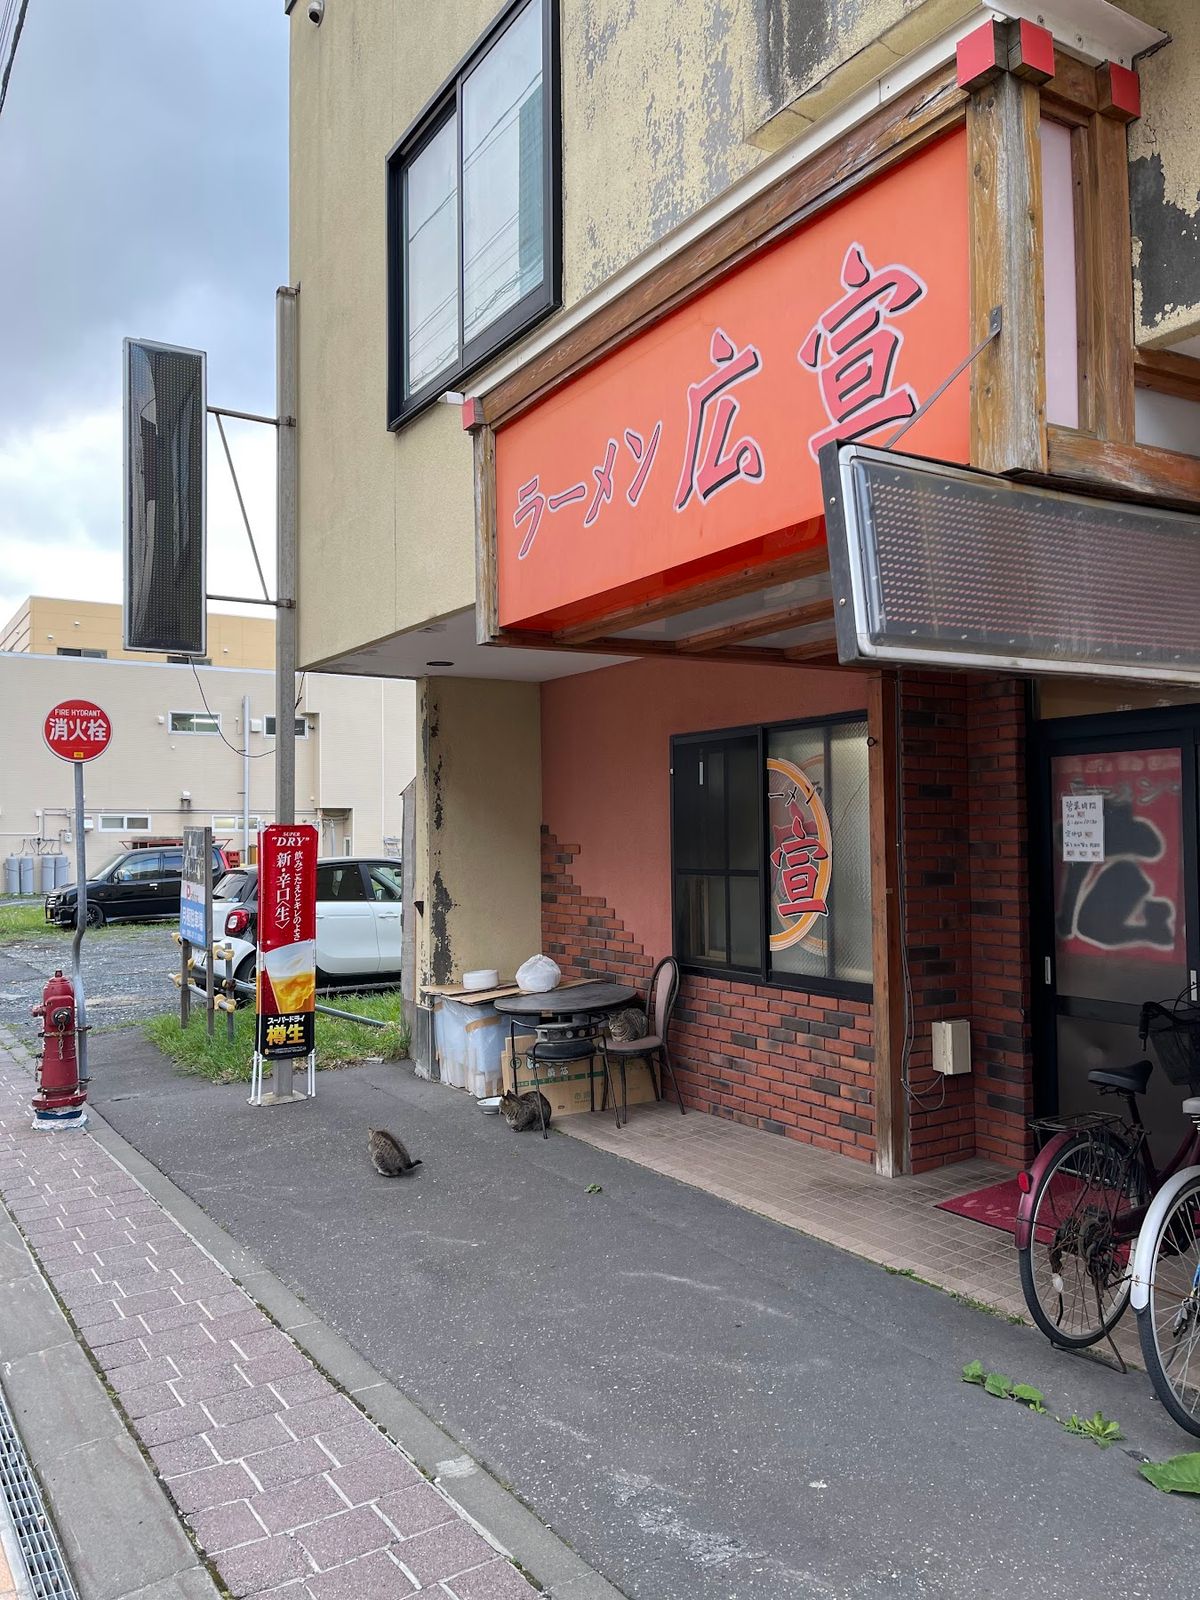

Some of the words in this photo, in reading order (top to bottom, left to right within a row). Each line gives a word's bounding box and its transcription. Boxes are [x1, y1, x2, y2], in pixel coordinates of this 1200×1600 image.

[49, 717, 108, 741] 消火栓
[770, 815, 829, 918] 宣
[267, 1014, 306, 1025] スーパードライ
[266, 1023, 305, 1046] 樽生
